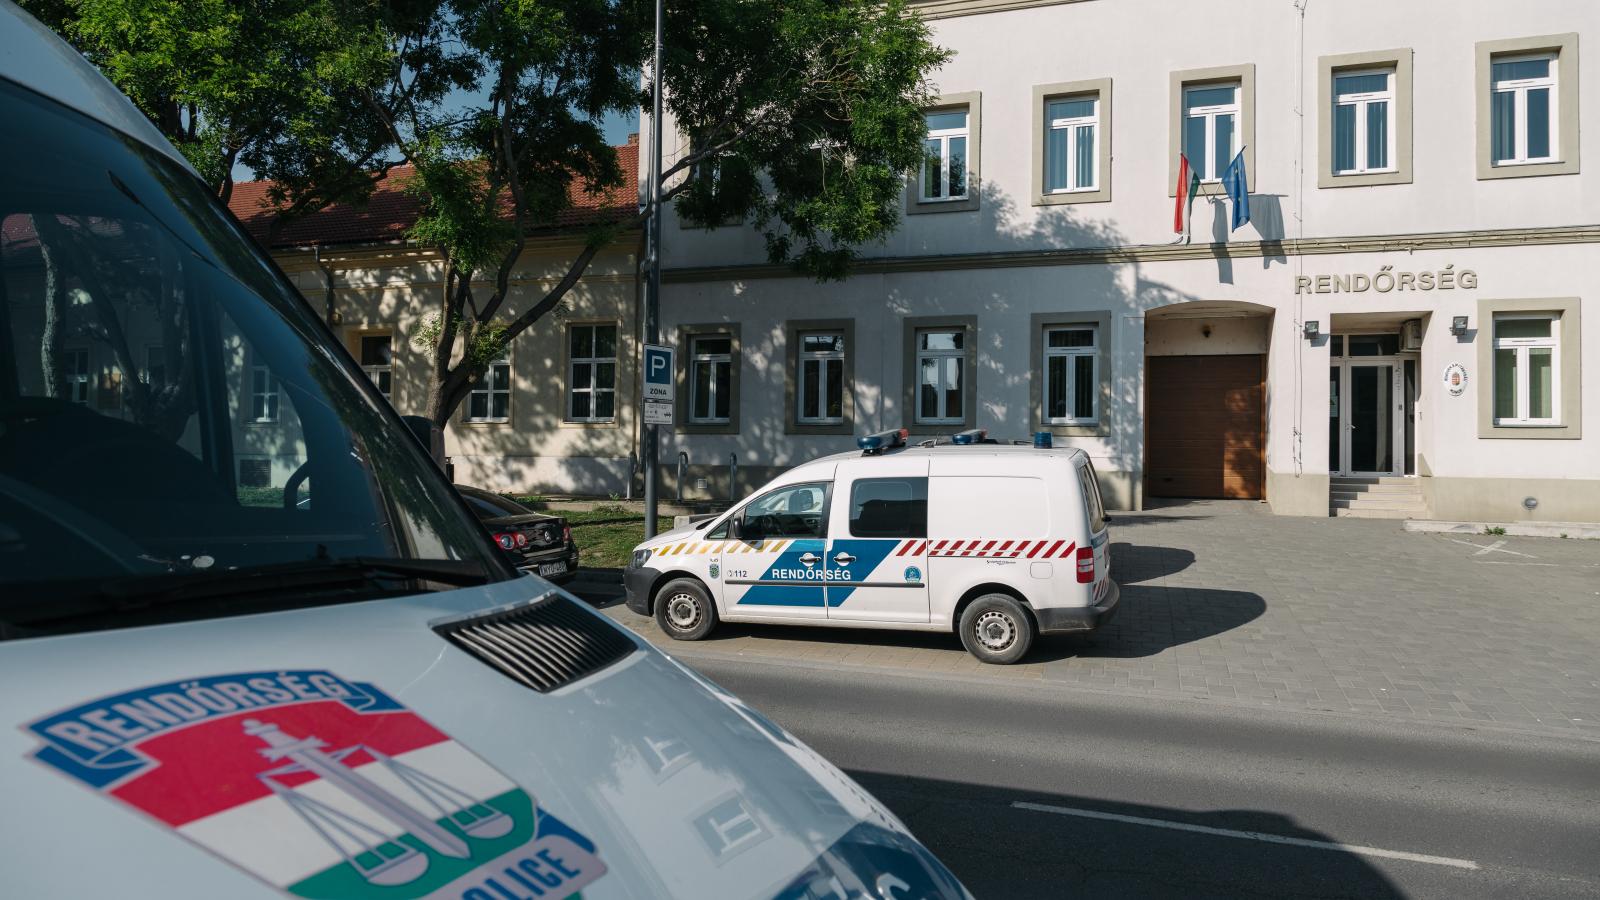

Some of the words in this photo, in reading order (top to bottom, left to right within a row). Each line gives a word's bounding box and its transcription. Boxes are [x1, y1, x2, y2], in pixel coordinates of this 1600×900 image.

[1294, 264, 1478, 294] RENDŐRSÉG
[652, 355, 666, 377] P
[734, 570, 748, 578] 112
[772, 567, 851, 580] RENDŐRSÉG
[46, 671, 347, 752] RENDŐRSÉG
